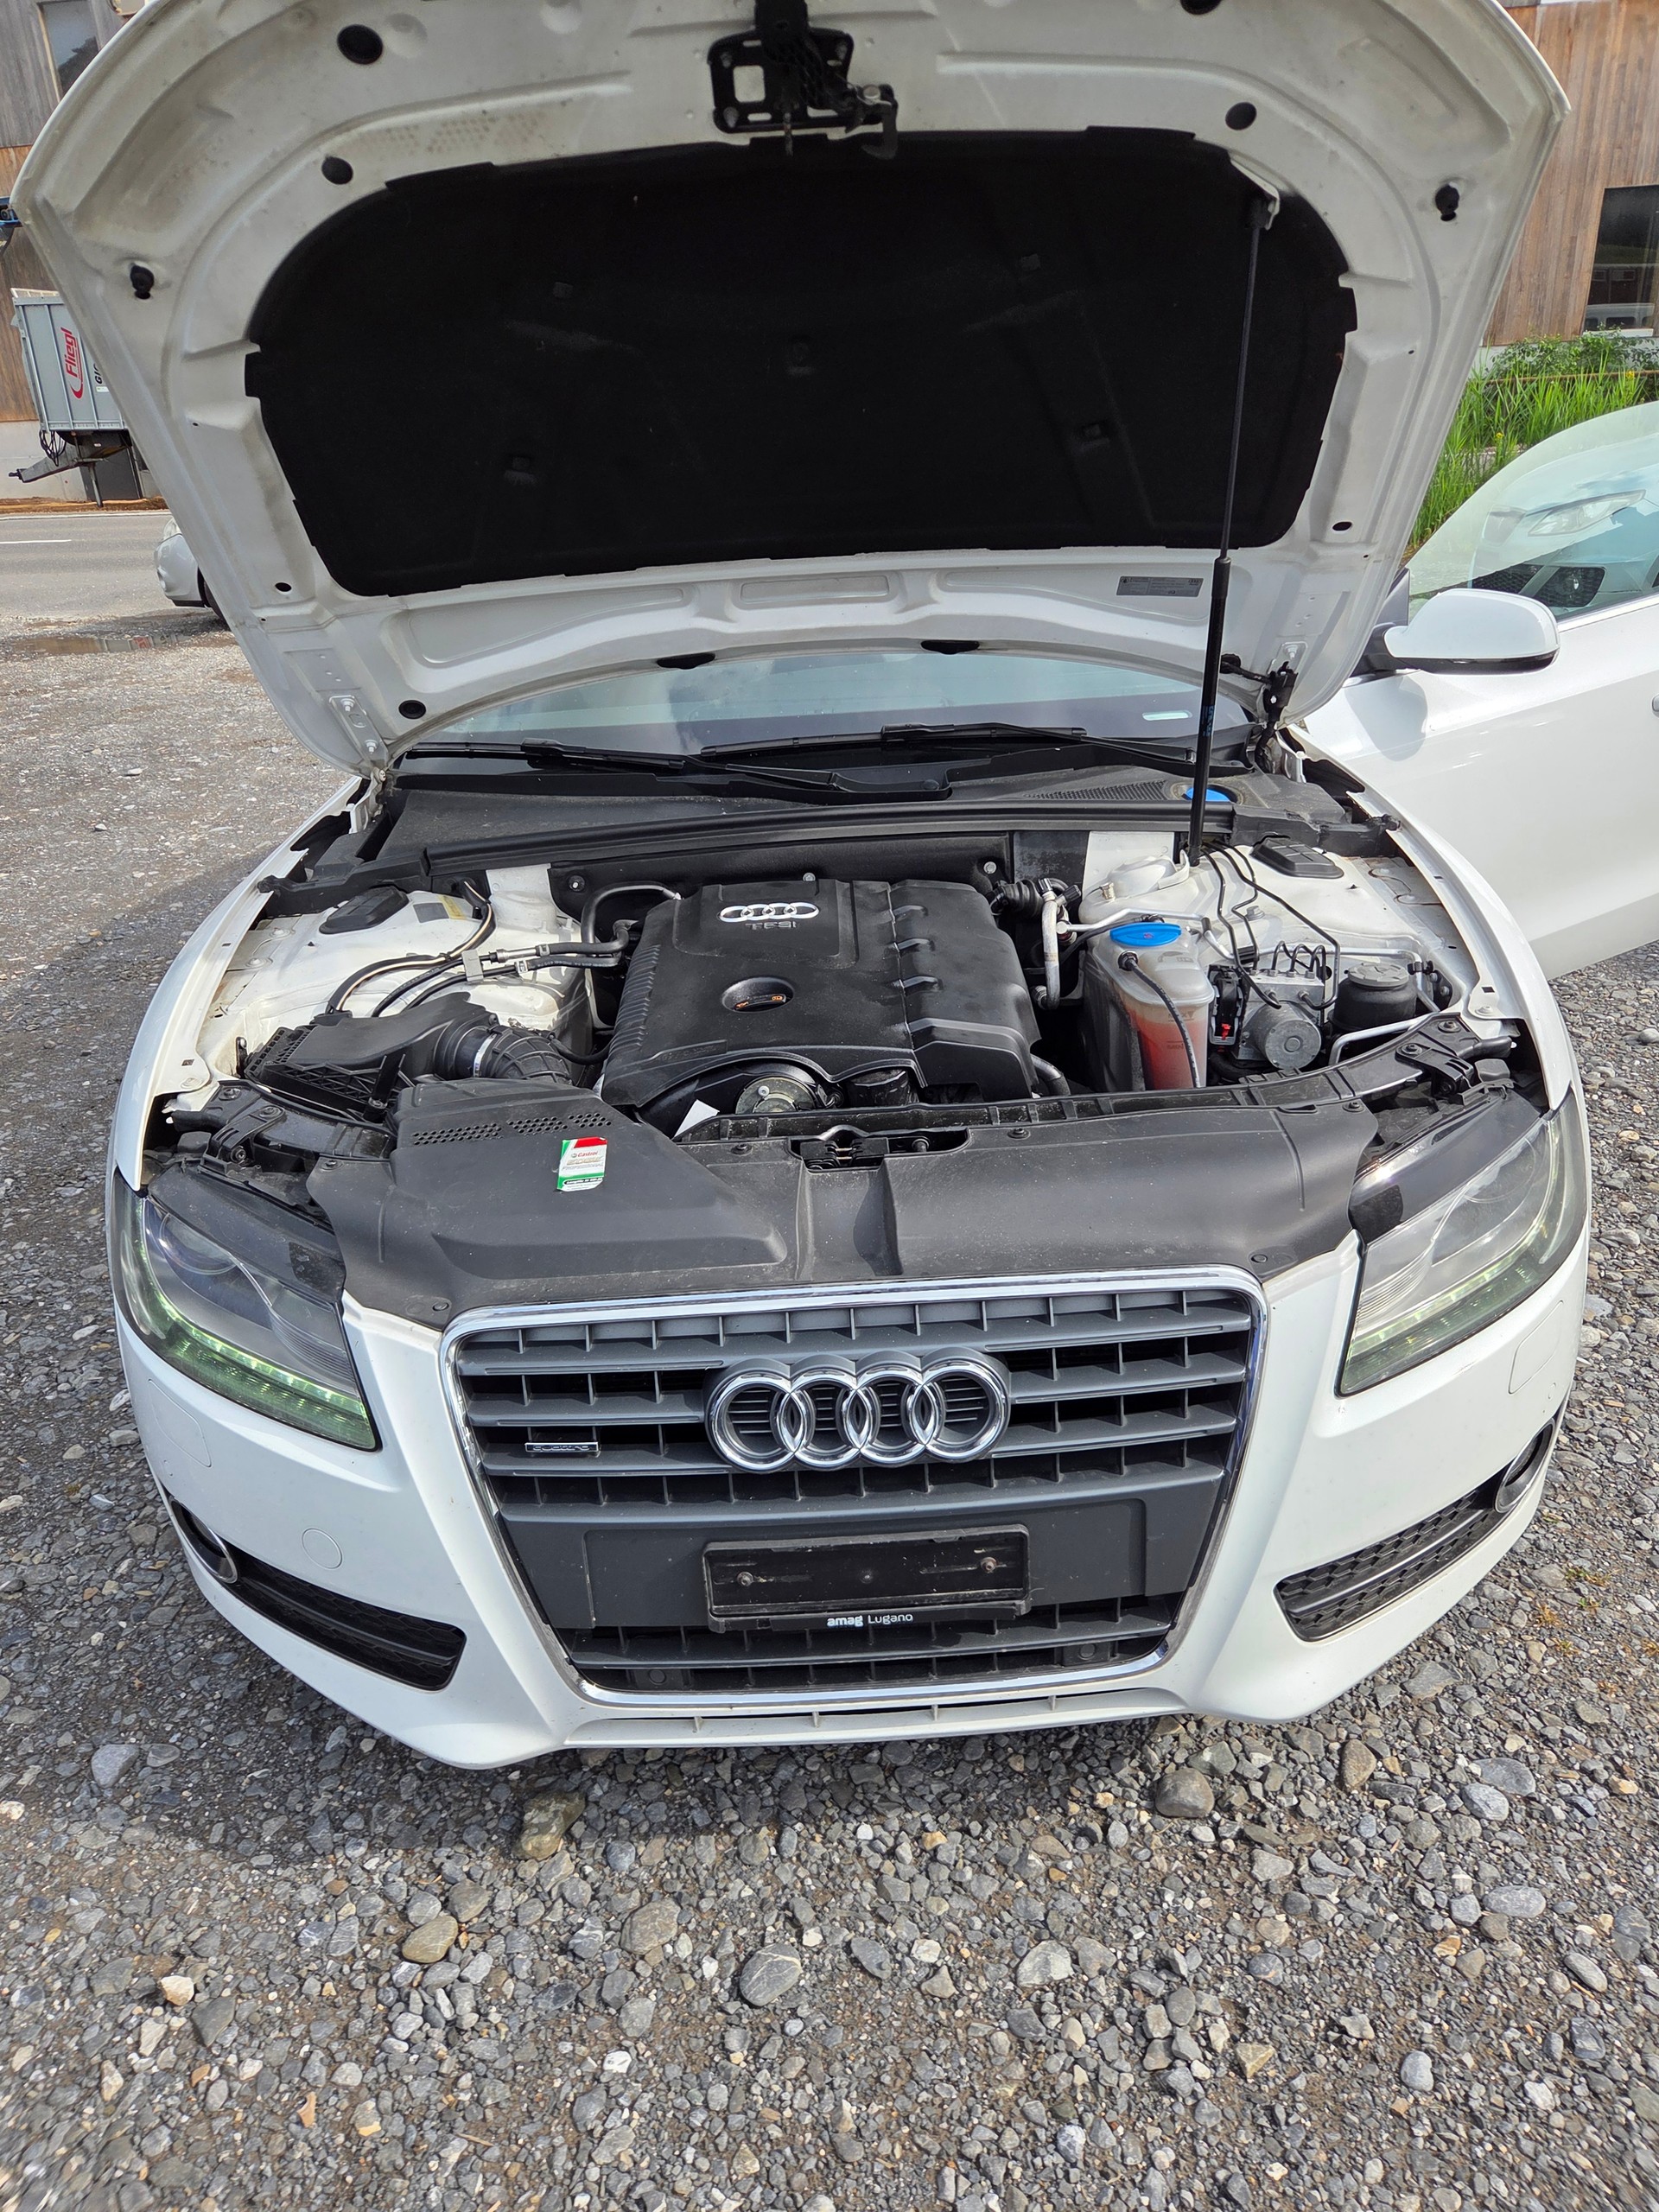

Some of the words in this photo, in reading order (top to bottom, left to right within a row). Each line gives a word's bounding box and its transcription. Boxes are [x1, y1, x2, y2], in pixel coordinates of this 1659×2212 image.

[60, 327, 78, 378] Fliegl
[827, 1615, 863, 1627] amag
[868, 1613, 913, 1624] Lugano
